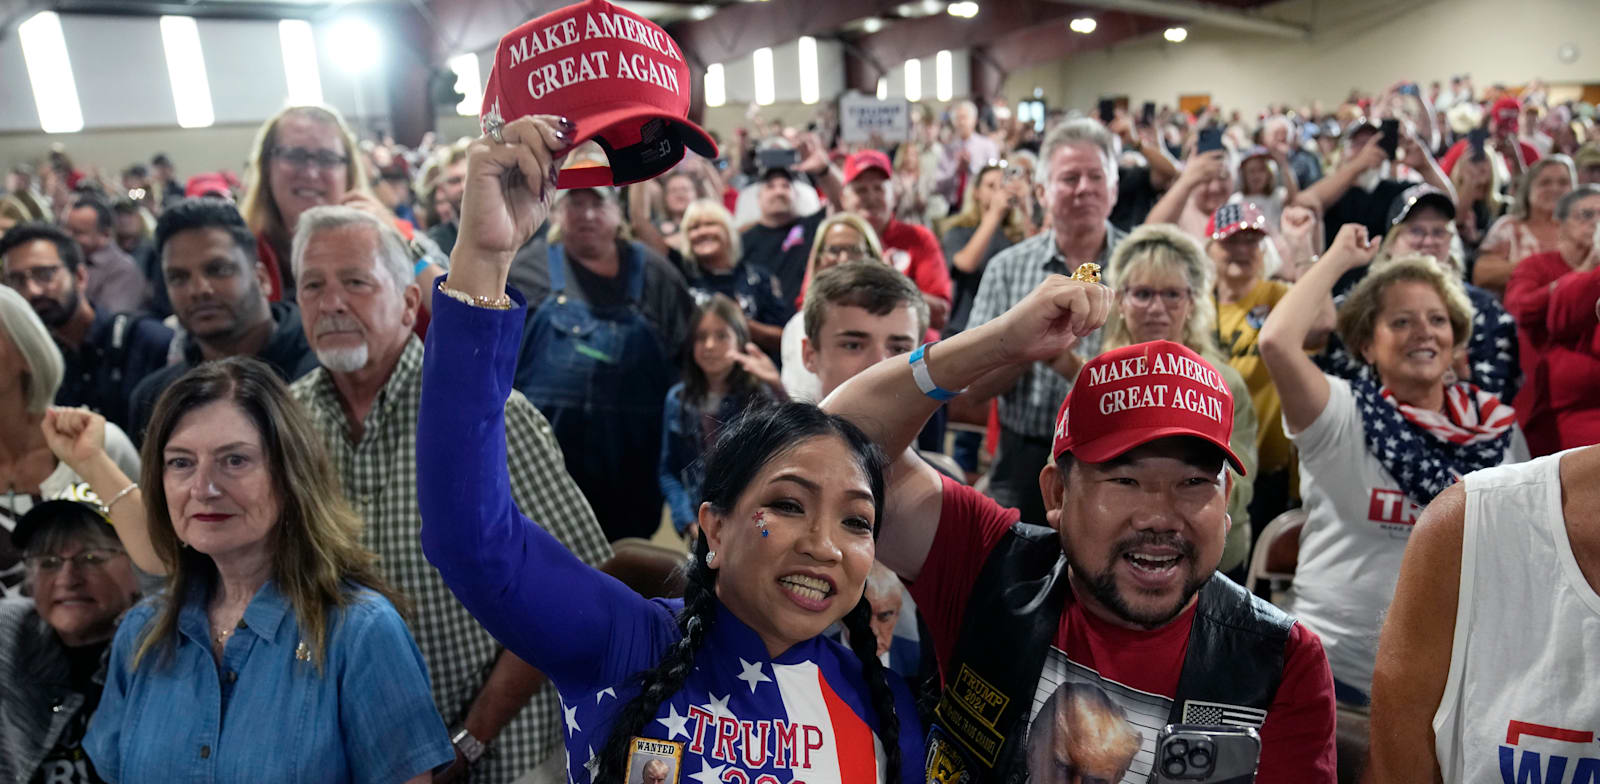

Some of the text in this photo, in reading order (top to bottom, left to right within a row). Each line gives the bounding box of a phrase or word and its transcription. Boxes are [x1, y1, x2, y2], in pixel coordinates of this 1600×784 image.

[509, 12, 682, 69] MAKE AMERICA
[527, 50, 680, 99] GREAT AGAIN
[1088, 352, 1229, 395] MAKE AMERICA
[1099, 384, 1223, 424] GREAT AGAIN
[963, 669, 1003, 707] TRUMP
[965, 688, 986, 714] 2024
[637, 741, 675, 755] WANTED
[689, 705, 823, 769] TRUMP
